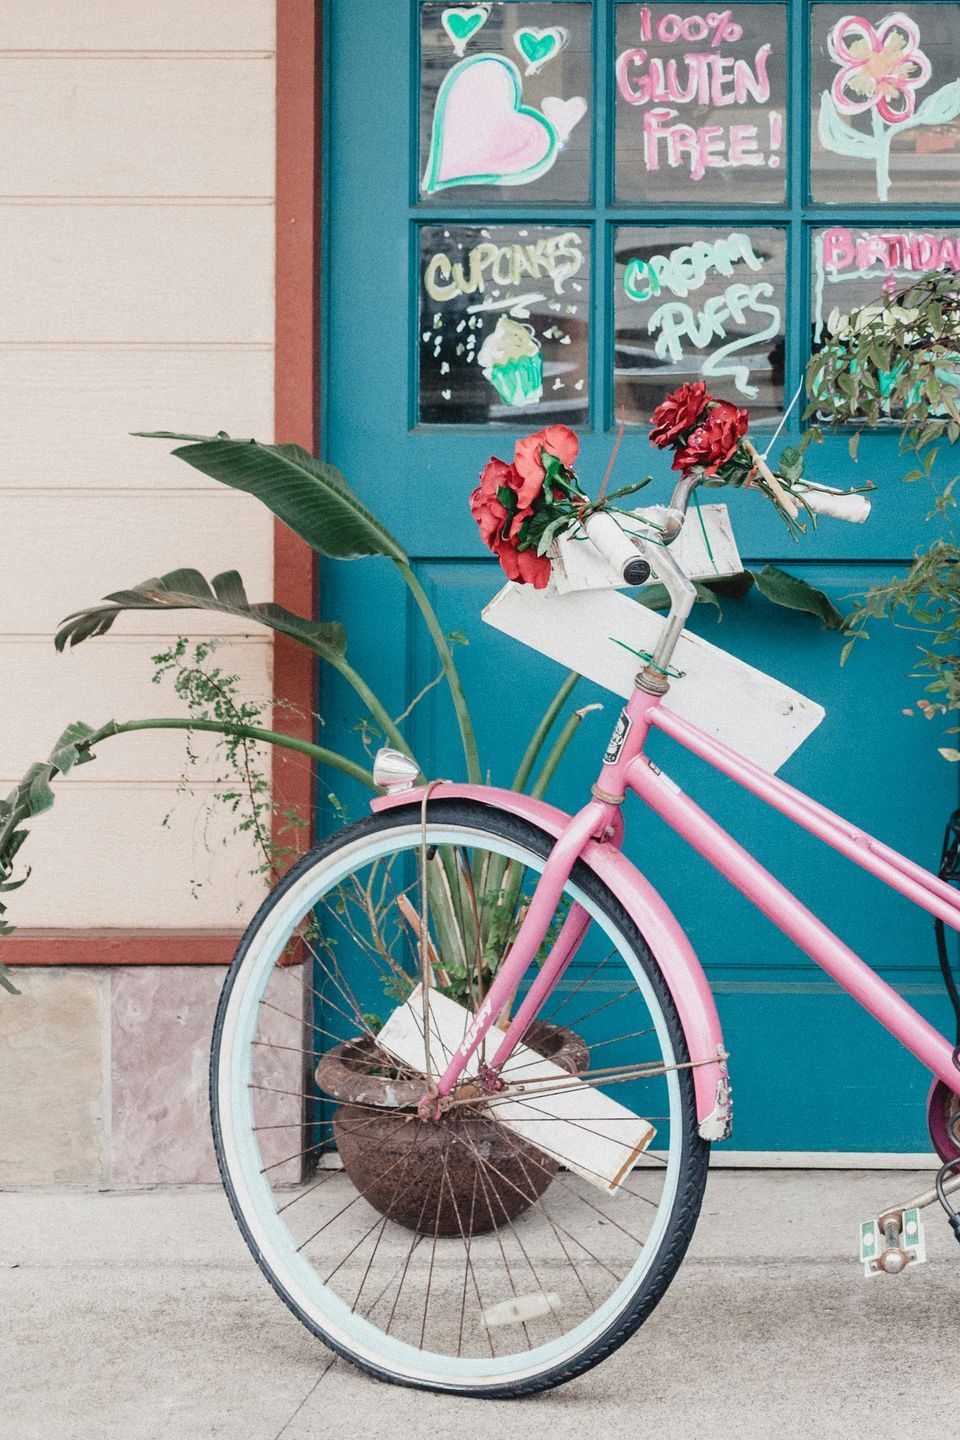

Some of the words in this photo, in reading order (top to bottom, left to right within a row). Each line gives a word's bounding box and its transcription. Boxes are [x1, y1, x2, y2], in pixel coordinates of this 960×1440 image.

[640, 7, 744, 47] 100%
[615, 43, 773, 106] GLUTEN
[643, 107, 783, 181] FREE!
[623, 233, 765, 302] CREAM
[648, 282, 781, 399] PUFFS
